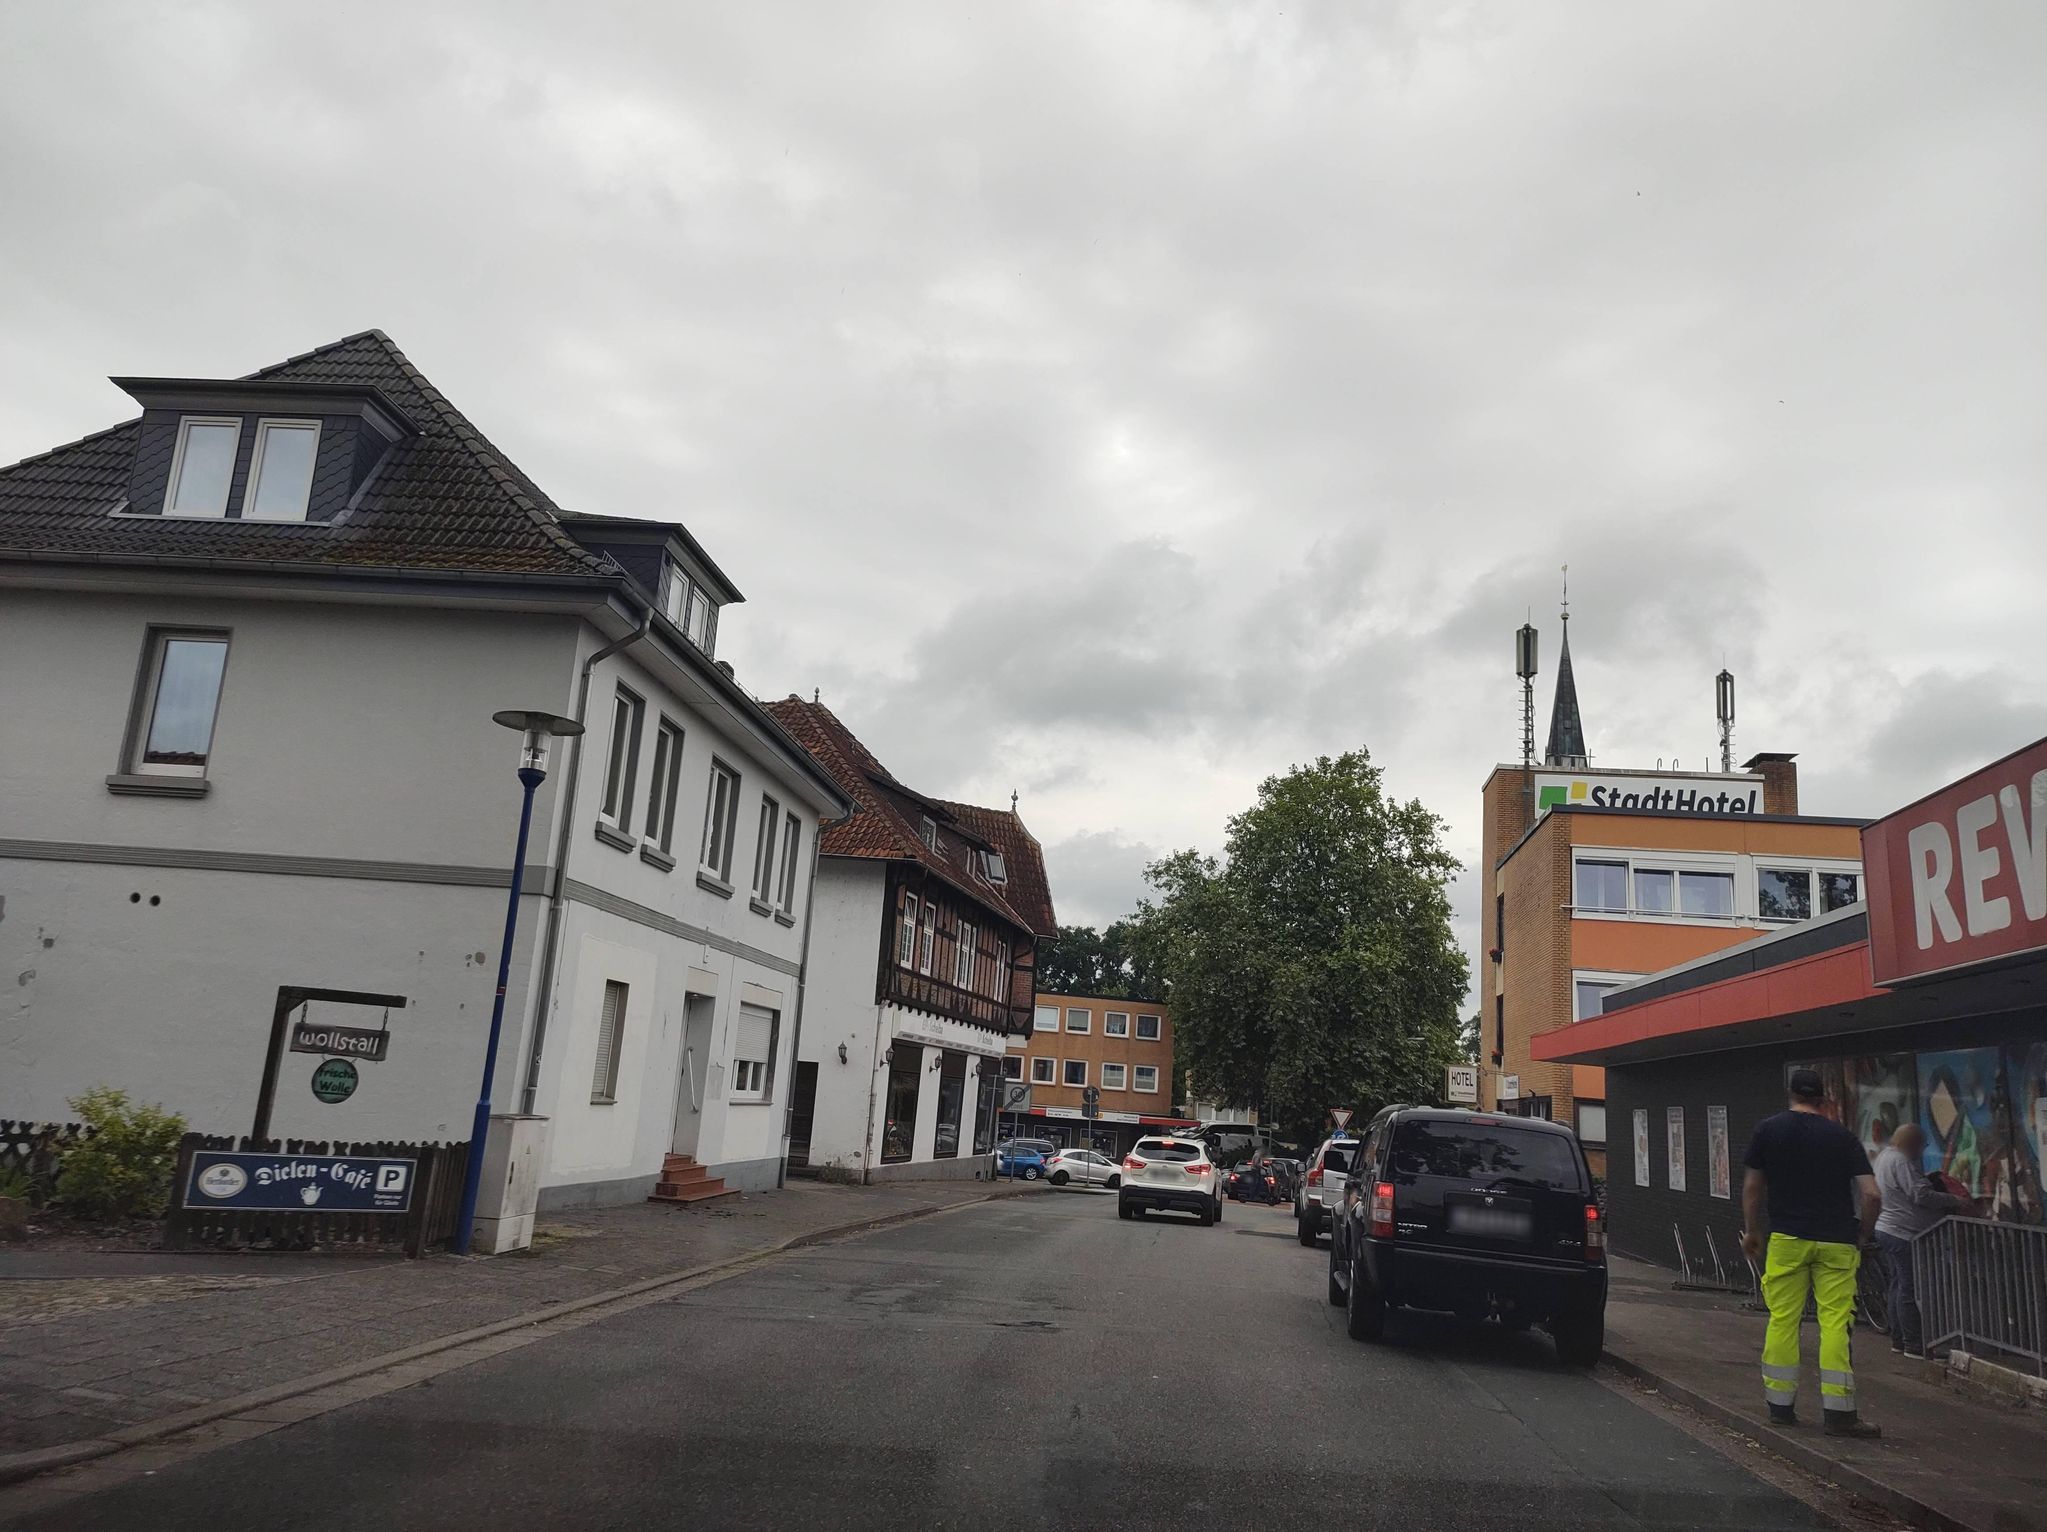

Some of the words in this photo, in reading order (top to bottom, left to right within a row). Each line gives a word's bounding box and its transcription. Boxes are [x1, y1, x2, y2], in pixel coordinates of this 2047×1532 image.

[1591, 785, 1757, 814] StadtHotel
[299, 1031, 379, 1055] wollstall
[319, 1080, 352, 1093] Wolle
[1451, 1071, 1474, 1087] HOTEL
[383, 1169, 400, 1188] P
